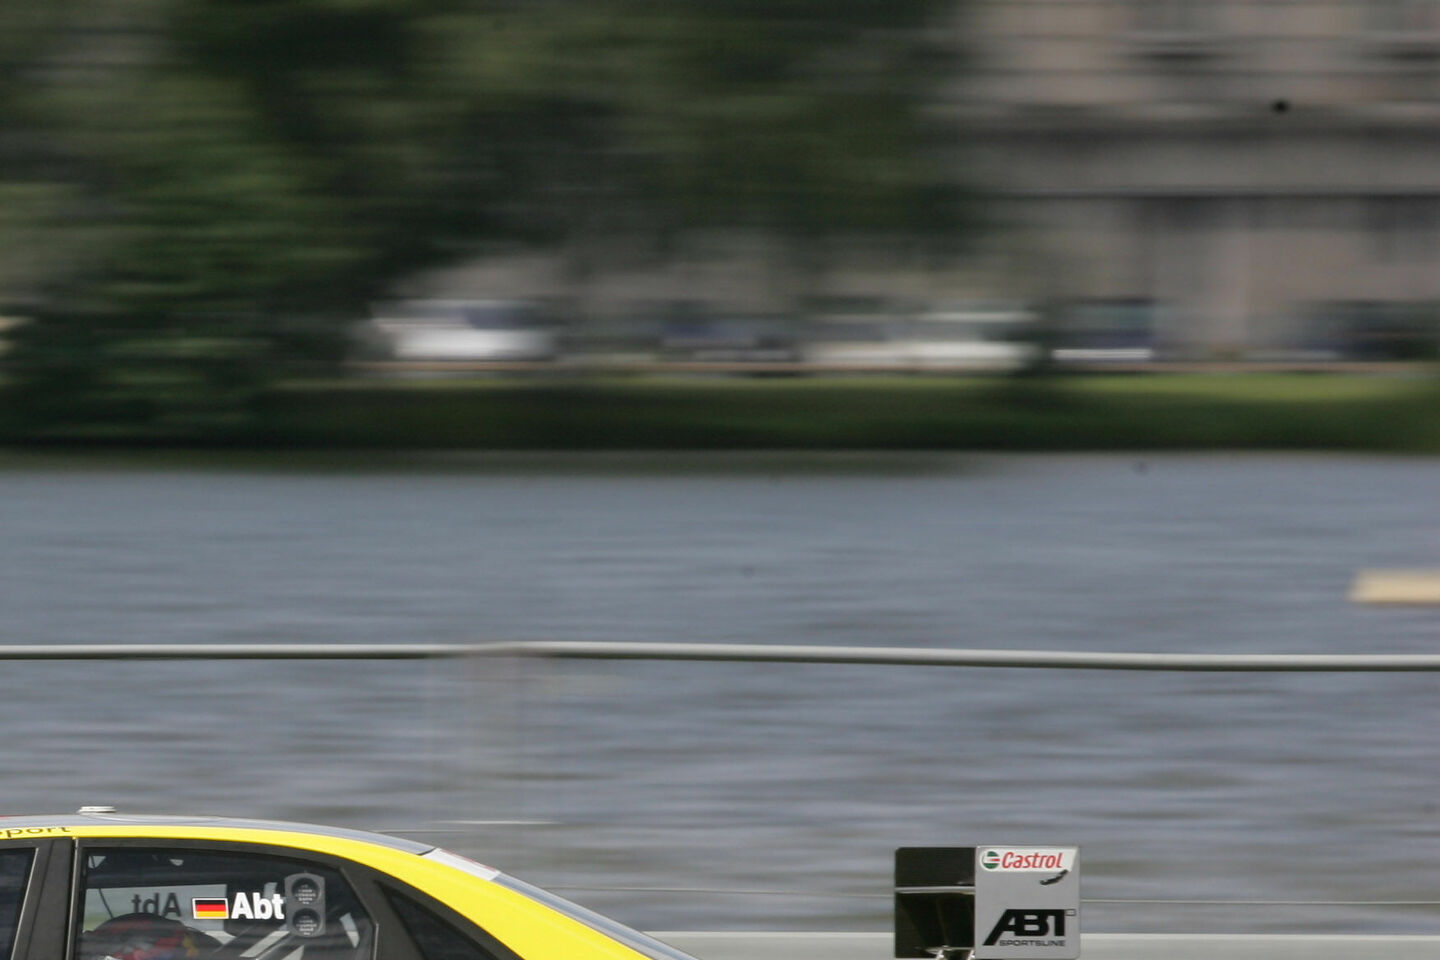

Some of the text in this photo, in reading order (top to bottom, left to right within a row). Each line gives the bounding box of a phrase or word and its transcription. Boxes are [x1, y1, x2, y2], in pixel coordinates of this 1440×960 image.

[1002, 851, 1064, 869] Castrol
[231, 892, 285, 920] Abt
[982, 908, 1065, 946] ABT
[999, 939, 1065, 947] SPORTSLINE
